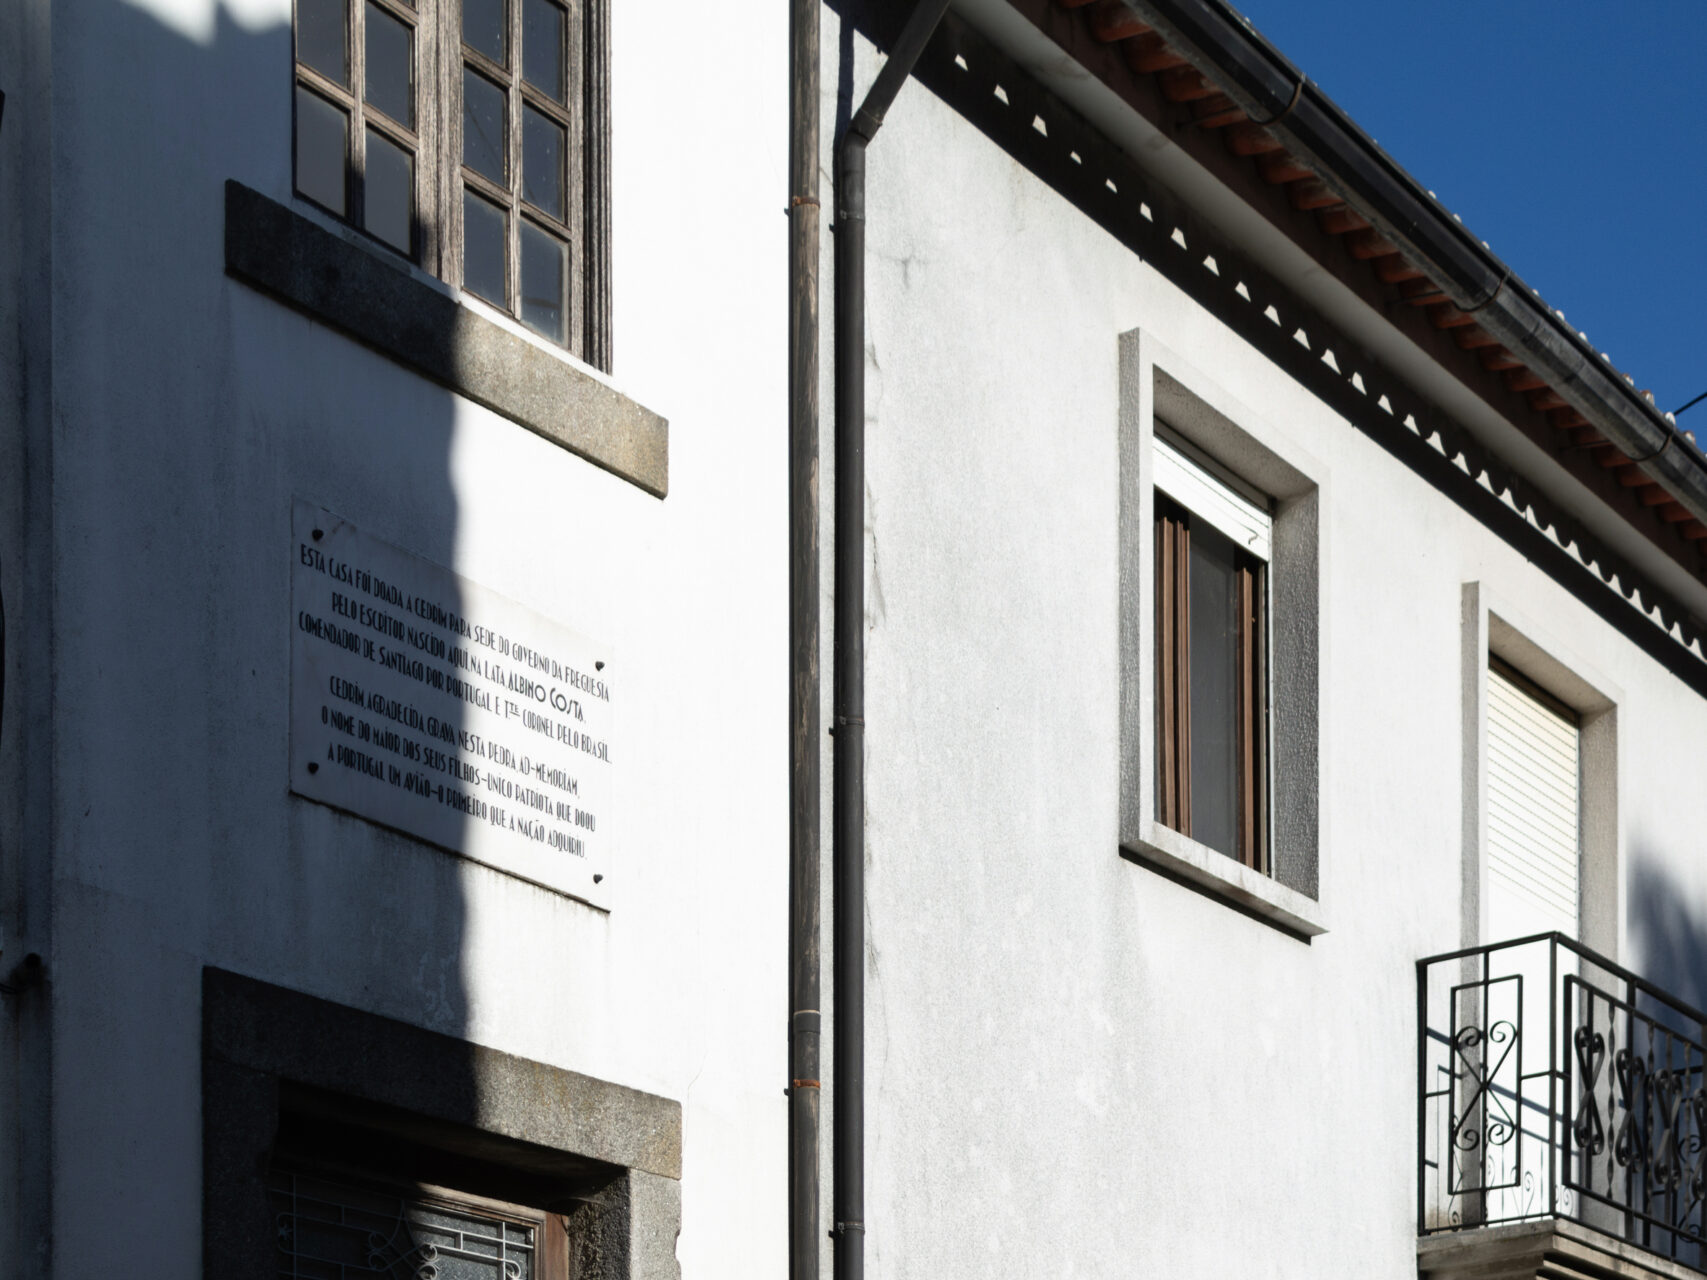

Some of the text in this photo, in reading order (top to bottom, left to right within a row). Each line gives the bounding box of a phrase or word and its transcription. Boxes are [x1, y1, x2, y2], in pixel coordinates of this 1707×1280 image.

[300, 543, 325, 575] ESTA
[328, 557, 353, 587] CASA
[355, 569, 371, 595] FOI
[373, 577, 403, 609] DOADA
[406, 594, 412, 613] A
[414, 597, 447, 629] CEDRIM
[449, 612, 471, 640] PARA
[474, 625, 496, 650] SEDE
[499, 635, 509, 656] DO
[512, 643, 549, 674] GOVERNO
[552, 660, 562, 681] DA
[332, 591, 356, 621] PELO
[359, 603, 405, 642] ESCRITOR
[407, 626, 445, 660] NASCIDO
[298, 610, 361, 655] COMENDADOR
[363, 638, 375, 662] DE
[378, 646, 423, 682] SANTIAGO
[426, 665, 444, 691] POR
[446, 674, 492, 712] PORTUGAL
[495, 696, 500, 715] E
[523, 709, 554, 739] CORONEL
[557, 723, 579, 749] PELO
[322, 705, 327, 724] O
[331, 709, 355, 736] NOME
[358, 719, 370, 742] DO
[373, 726, 400, 755] MAIOR
[403, 738, 420, 762] DOS
[423, 746, 446, 772] SEUS
[515, 784, 553, 815] PATRIOTA
[556, 801, 571, 823] QUE
[575, 808, 595, 832] DOOU
[327, 742, 334, 762] A
[337, 744, 385, 782] PORTUGAL
[388, 764, 401, 787] UM
[446, 787, 487, 820] PRIMEIRO
[490, 806, 506, 828] QUE
[509, 816, 514, 831] A
[458, 728, 485, 758] NESTA
